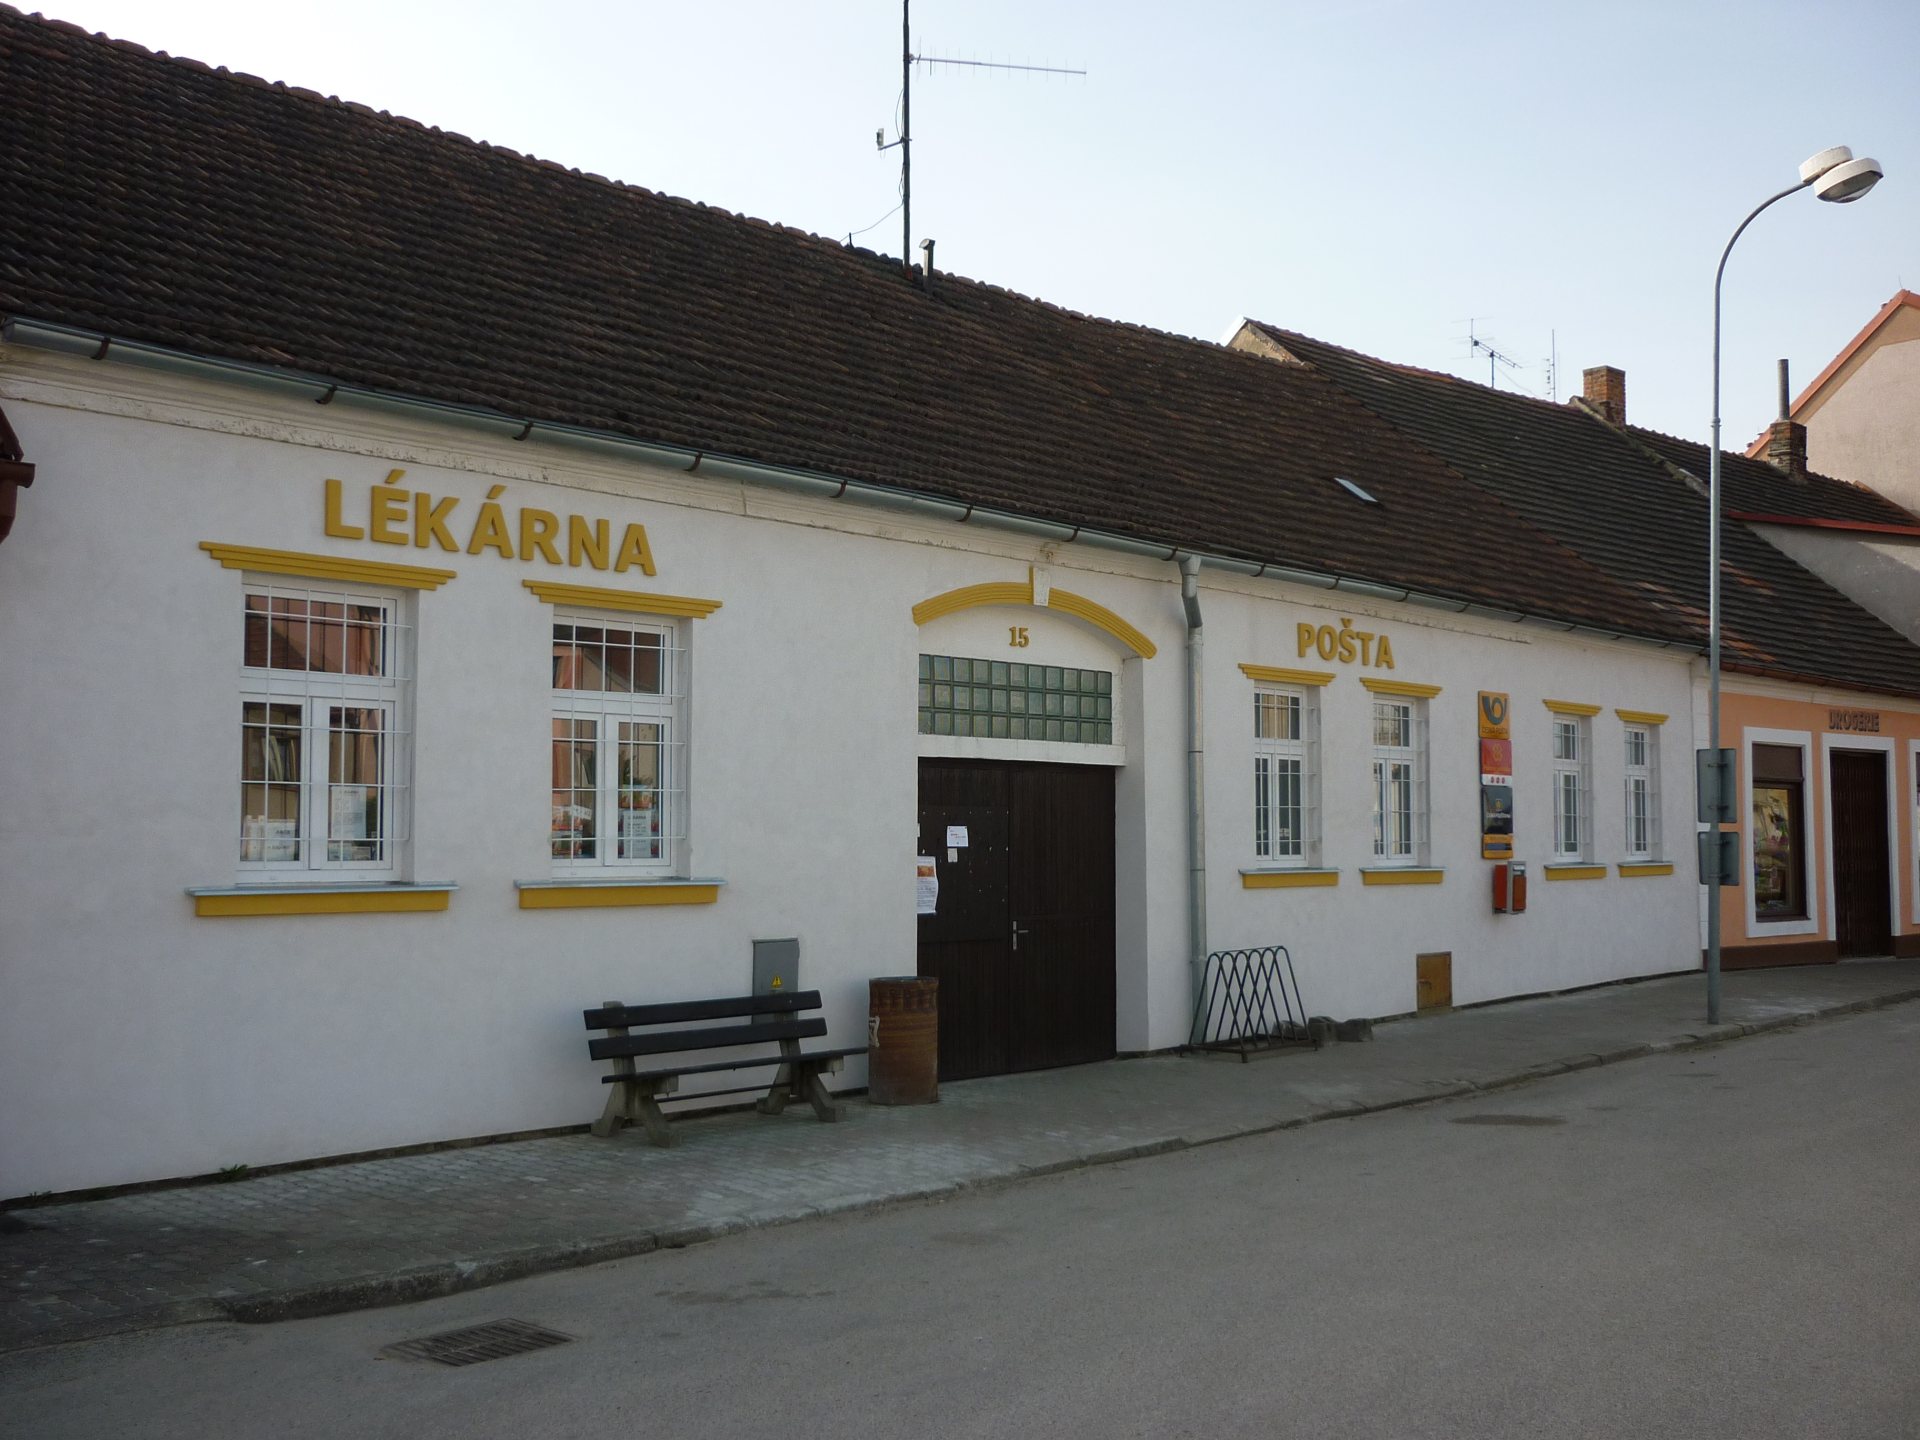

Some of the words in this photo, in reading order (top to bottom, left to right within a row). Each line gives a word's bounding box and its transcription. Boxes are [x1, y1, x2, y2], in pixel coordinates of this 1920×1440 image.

[324, 469, 657, 577] LÉKÁRNA
[1008, 626, 1030, 648] 15
[1297, 617, 1395, 669] POŠTA
[1829, 709, 1880, 732] DROGERIE
